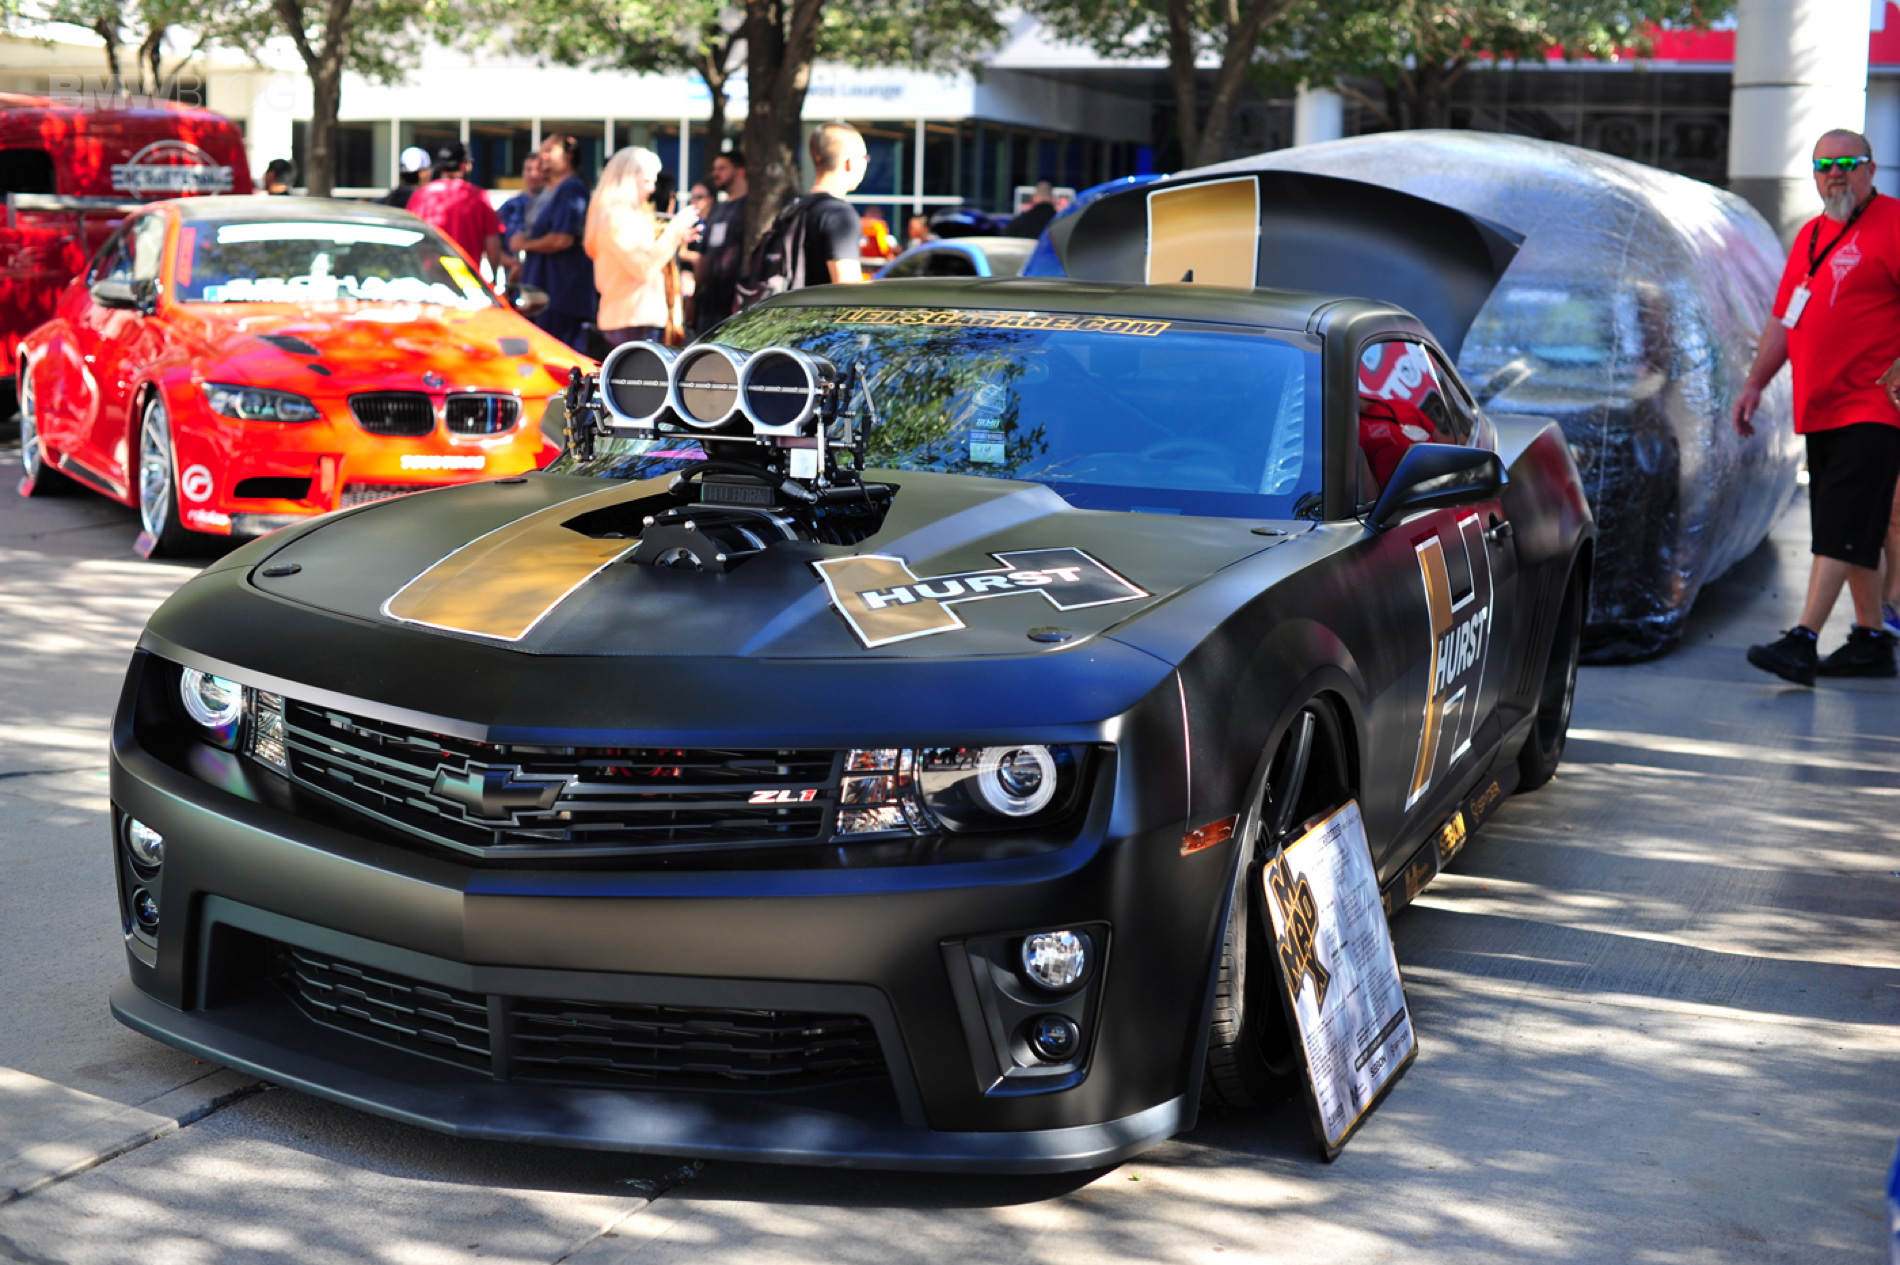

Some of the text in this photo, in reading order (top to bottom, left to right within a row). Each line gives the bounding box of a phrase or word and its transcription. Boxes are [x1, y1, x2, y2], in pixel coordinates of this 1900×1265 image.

[860, 566, 1082, 610] HURST
[1432, 605, 1489, 698] HURST
[747, 789, 818, 804] ZL1
